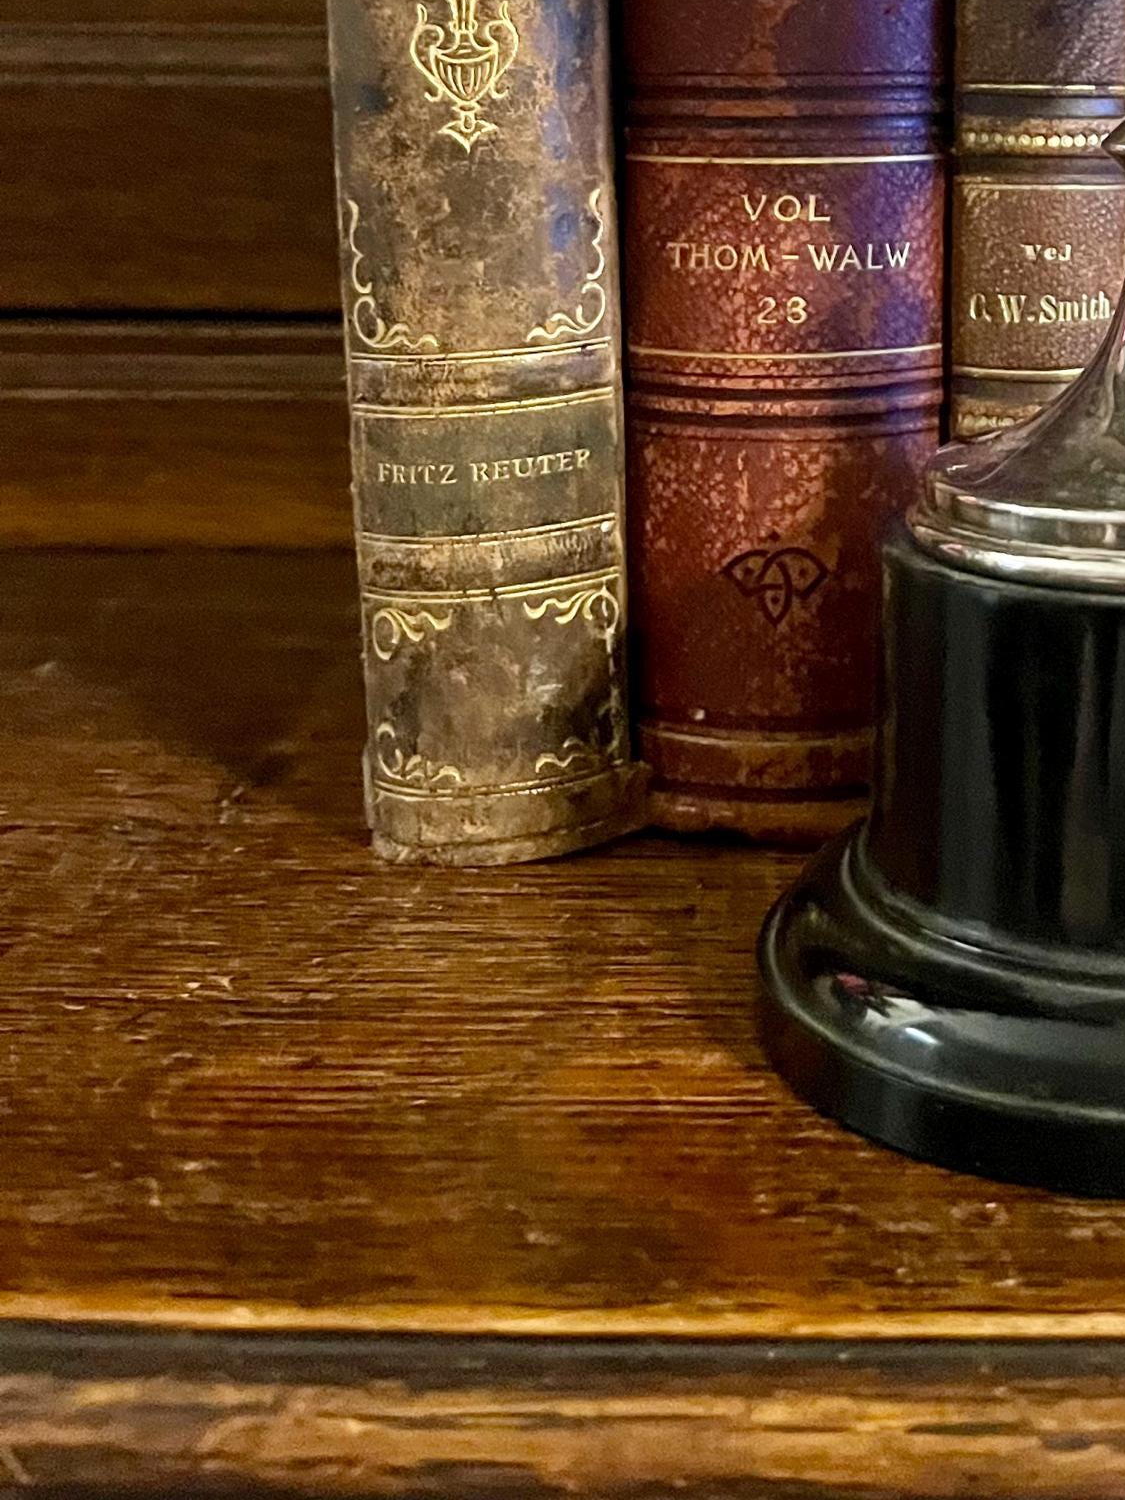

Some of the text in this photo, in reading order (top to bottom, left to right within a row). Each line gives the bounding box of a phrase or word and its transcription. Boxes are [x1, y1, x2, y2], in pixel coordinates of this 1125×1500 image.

[742, 194, 832, 223] VOL
[756, 297, 808, 325] 23
[377, 448, 593, 485] FRITZ REUTER
